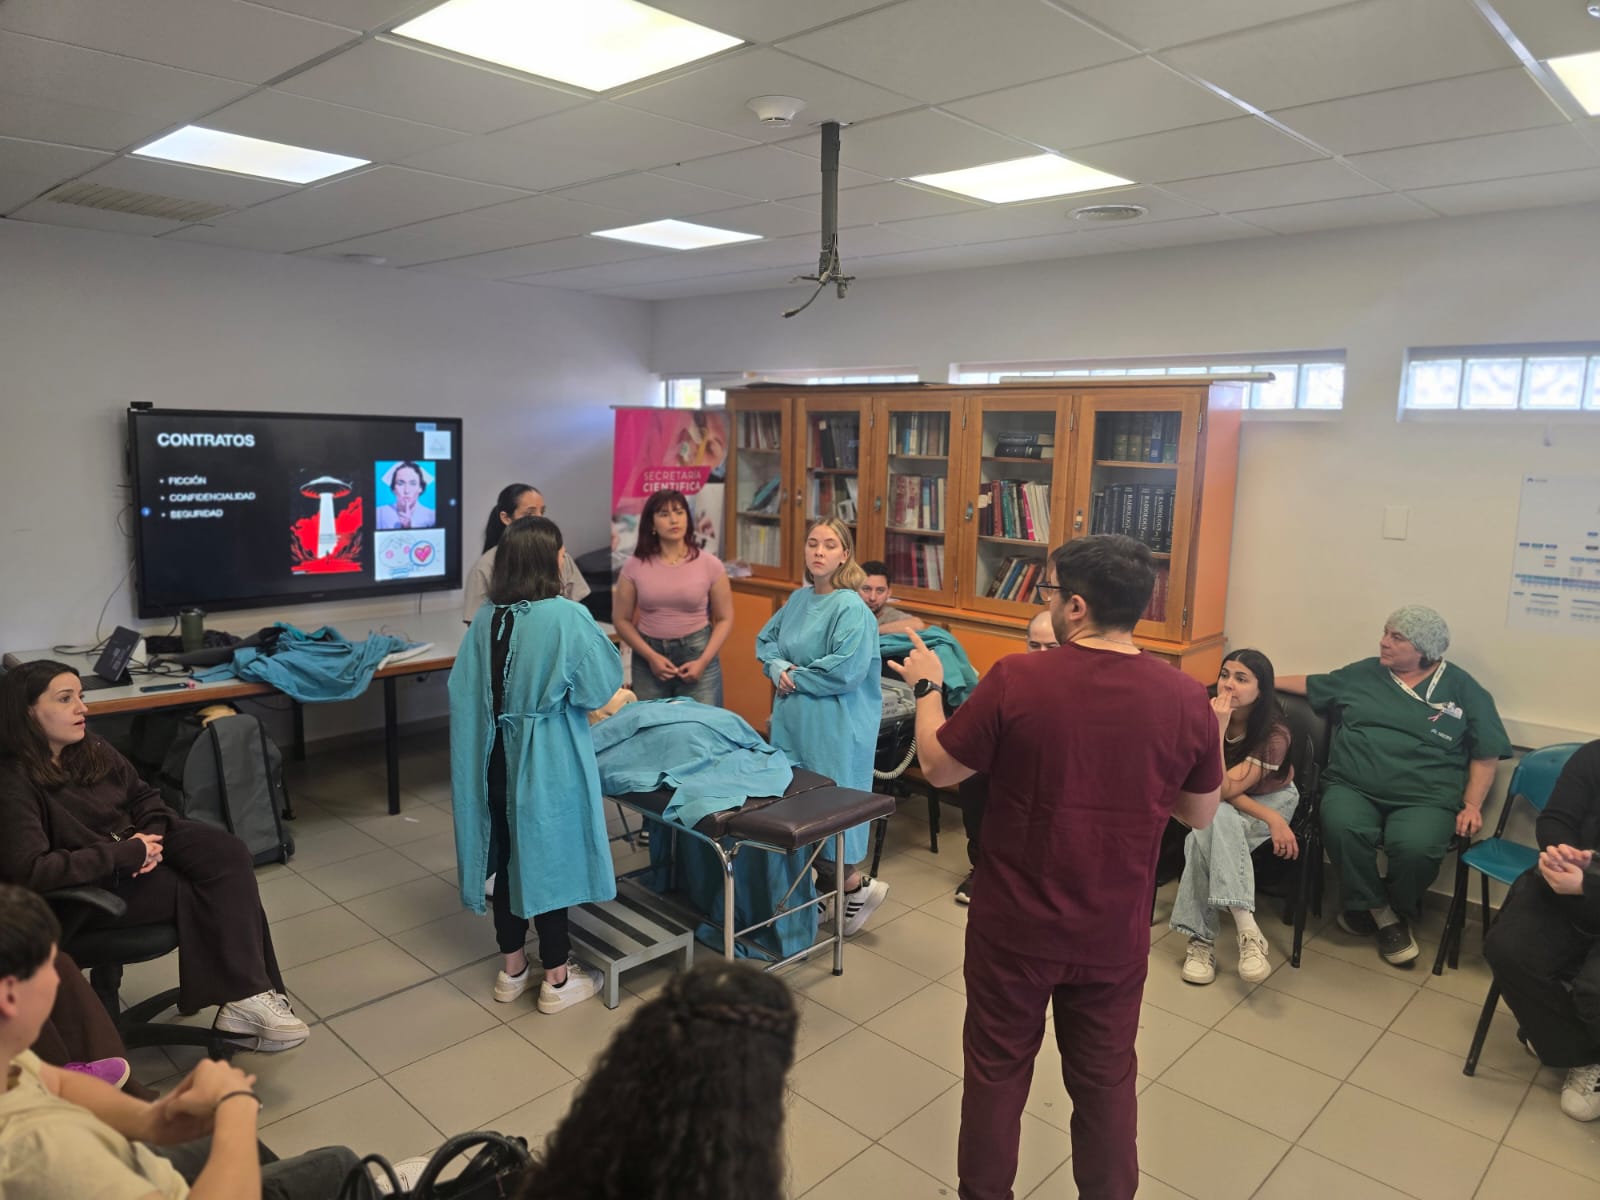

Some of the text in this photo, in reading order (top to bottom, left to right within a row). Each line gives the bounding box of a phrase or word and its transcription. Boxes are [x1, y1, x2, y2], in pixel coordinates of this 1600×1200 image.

[157, 432, 256, 447] CONTRATOS
[168, 474, 207, 486] FICCIÓN
[169, 492, 256, 503] CONFIDENCIALIDAD
[169, 508, 224, 520] SEGURIDAD
